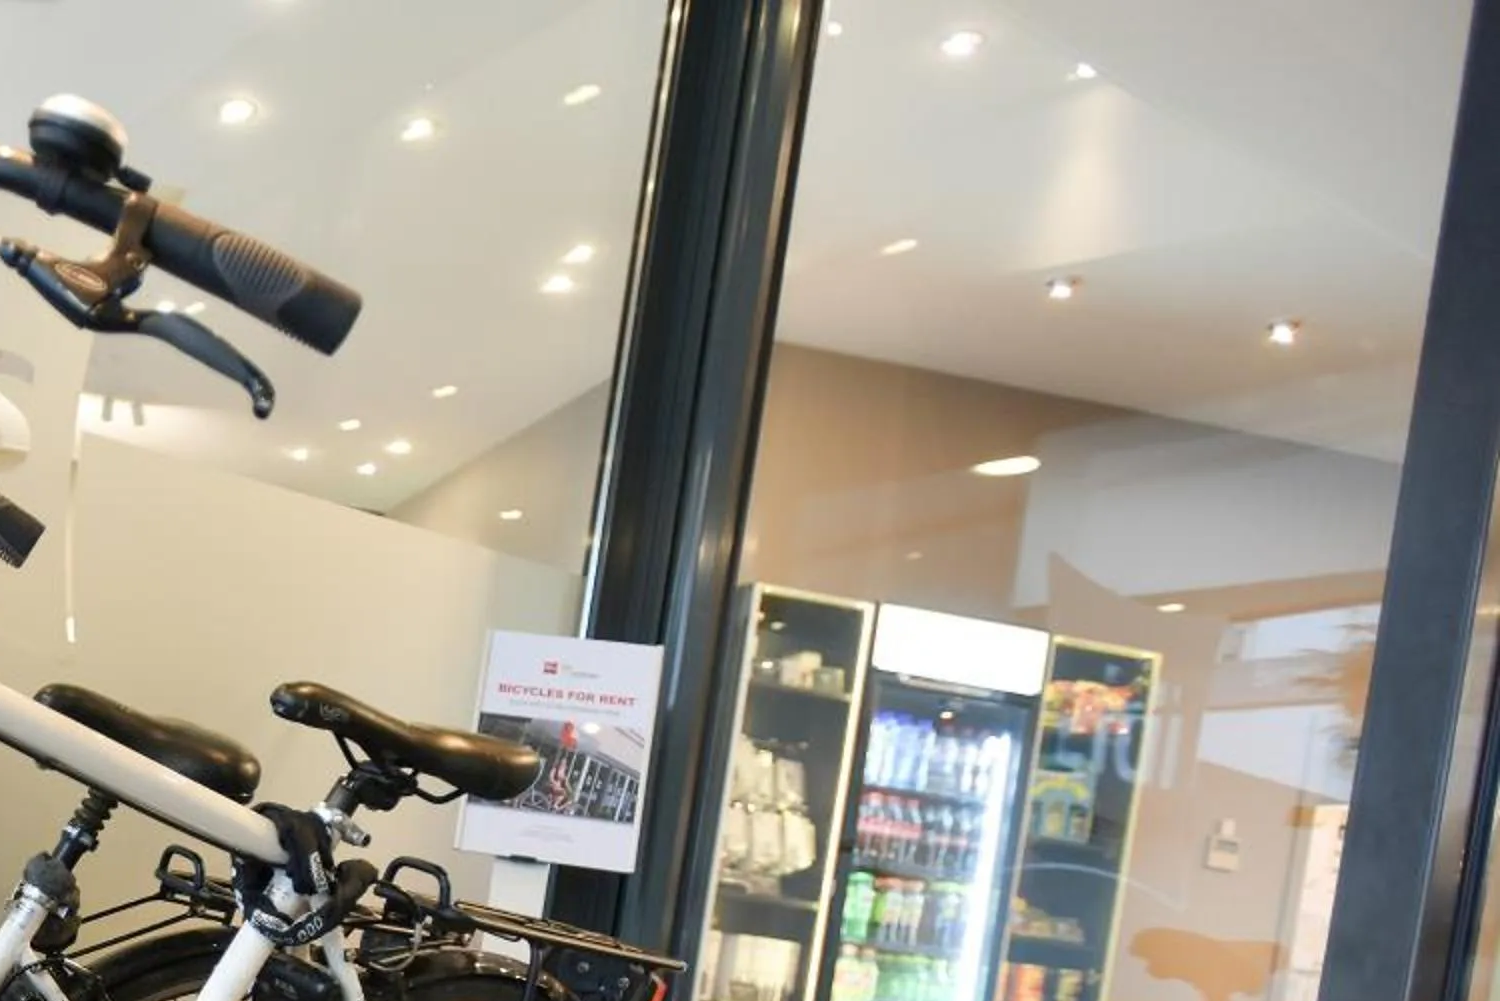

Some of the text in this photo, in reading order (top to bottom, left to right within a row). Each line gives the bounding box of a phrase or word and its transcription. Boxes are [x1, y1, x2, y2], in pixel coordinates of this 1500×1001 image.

[498, 683, 565, 700] BICYCLES
[567, 691, 596, 705] FOR
[599, 694, 638, 708] RENT
